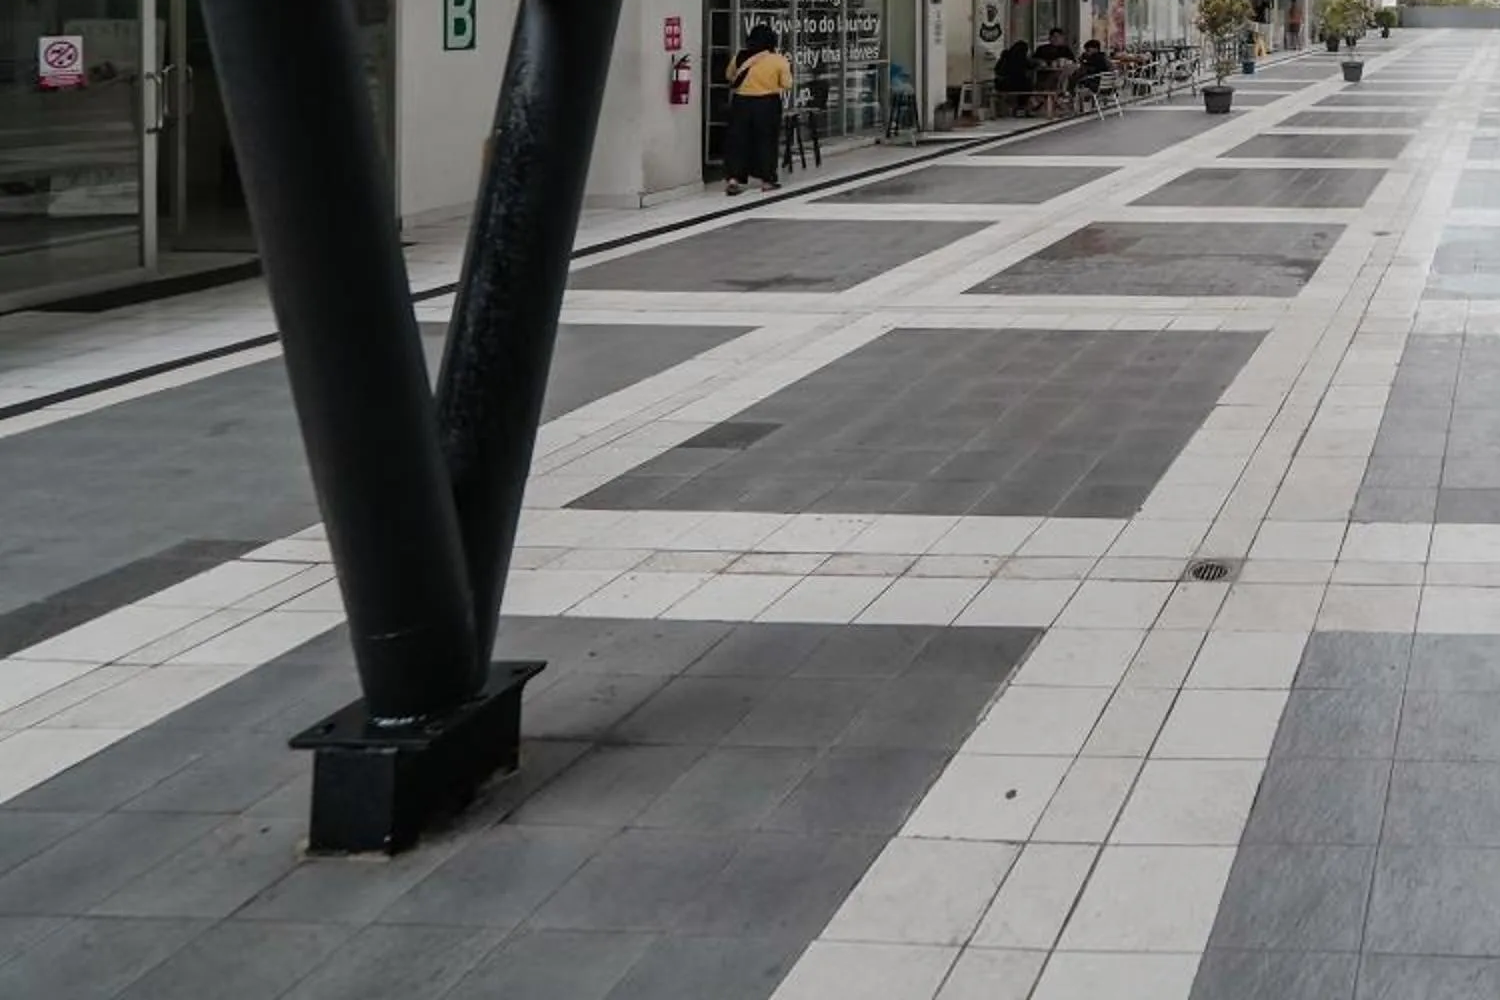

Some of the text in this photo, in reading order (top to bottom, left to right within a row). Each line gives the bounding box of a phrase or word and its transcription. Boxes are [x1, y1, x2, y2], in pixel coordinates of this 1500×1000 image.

[804, 17, 817, 33] to
[819, 16, 834, 33] do
[795, 46, 819, 68] city
